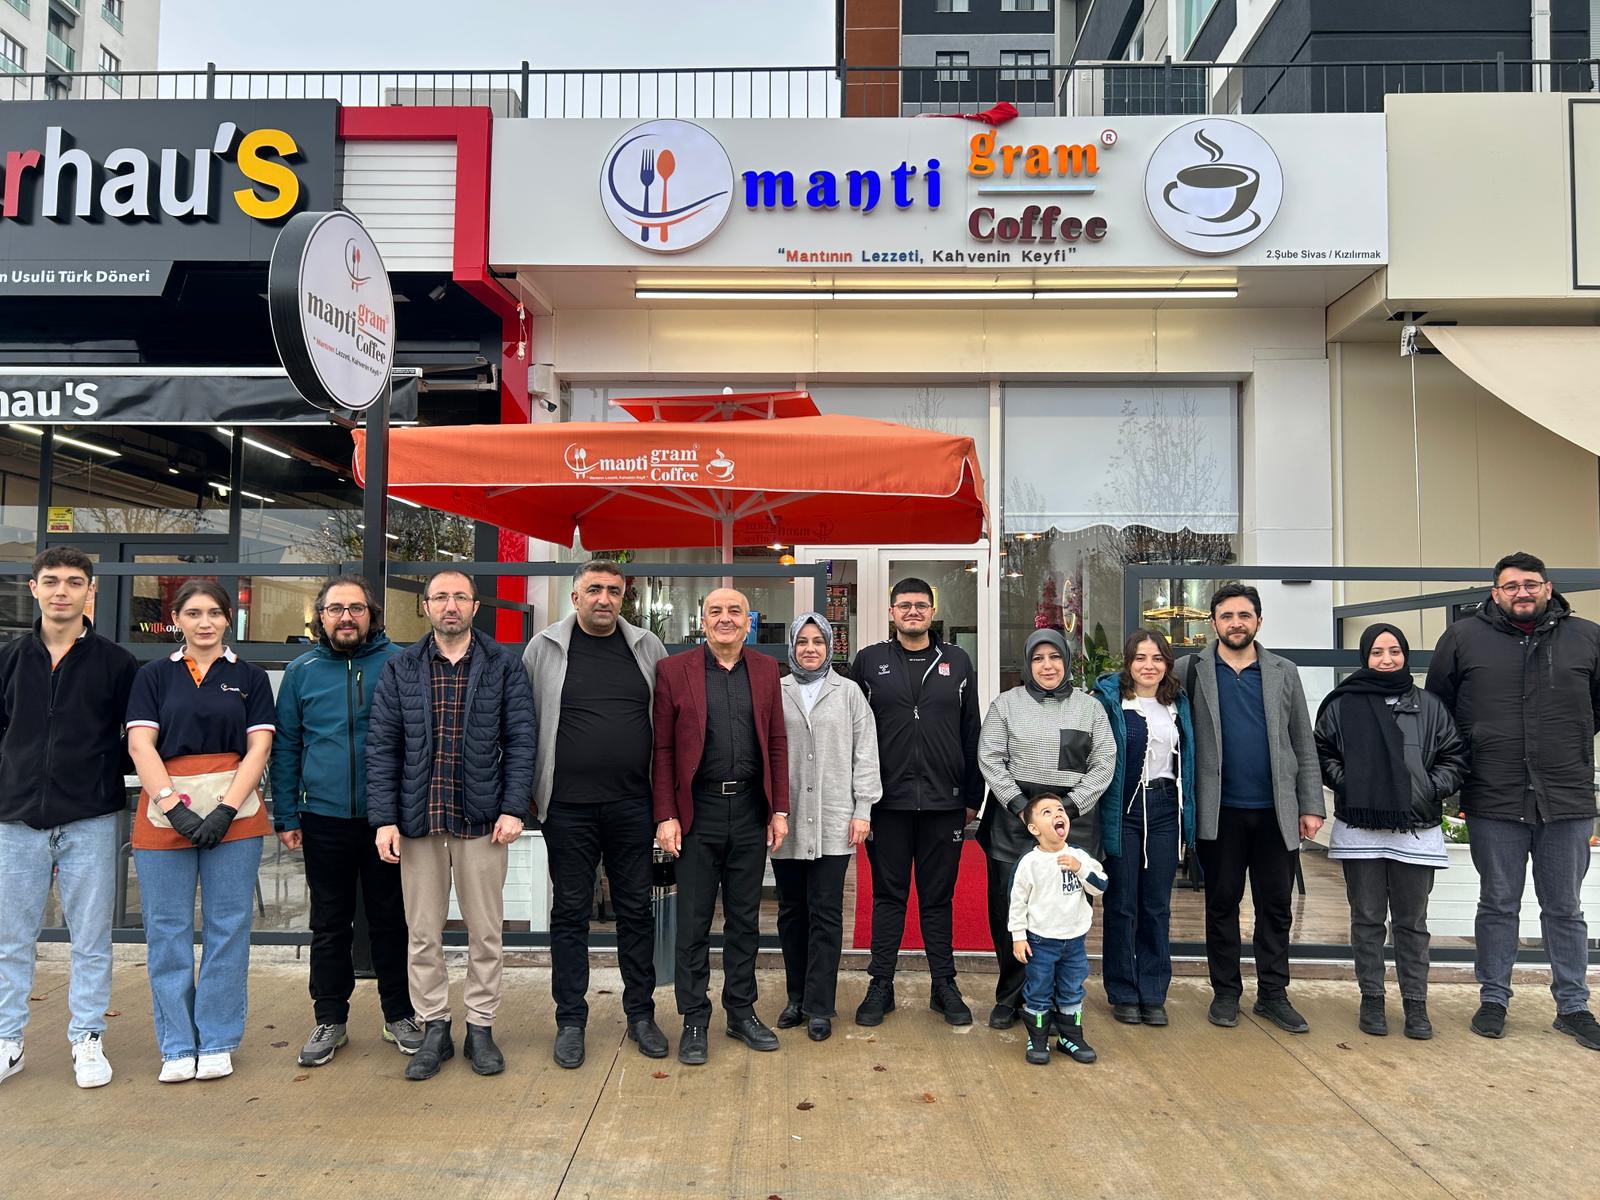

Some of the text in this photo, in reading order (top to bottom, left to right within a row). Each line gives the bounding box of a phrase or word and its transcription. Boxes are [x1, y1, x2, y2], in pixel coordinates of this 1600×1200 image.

[968, 128, 1101, 178] gram
[742, 158, 942, 214] manti
[968, 205, 1108, 243] Coffee
[862, 249, 924, 264] Lezzeti,
[1301, 249, 1327, 259] Sivas
[1335, 249, 1381, 259] Kızılırmak
[11, 270, 55, 283] Usulü
[58, 270, 92, 283] Türk
[96, 269, 150, 283] Döneri
[307, 291, 356, 338] manti
[357, 303, 386, 334] gram
[356, 333, 386, 365] Coffee
[600, 455, 648, 472] manti
[650, 449, 698, 464] gram
[650, 467, 699, 482] Coffee
